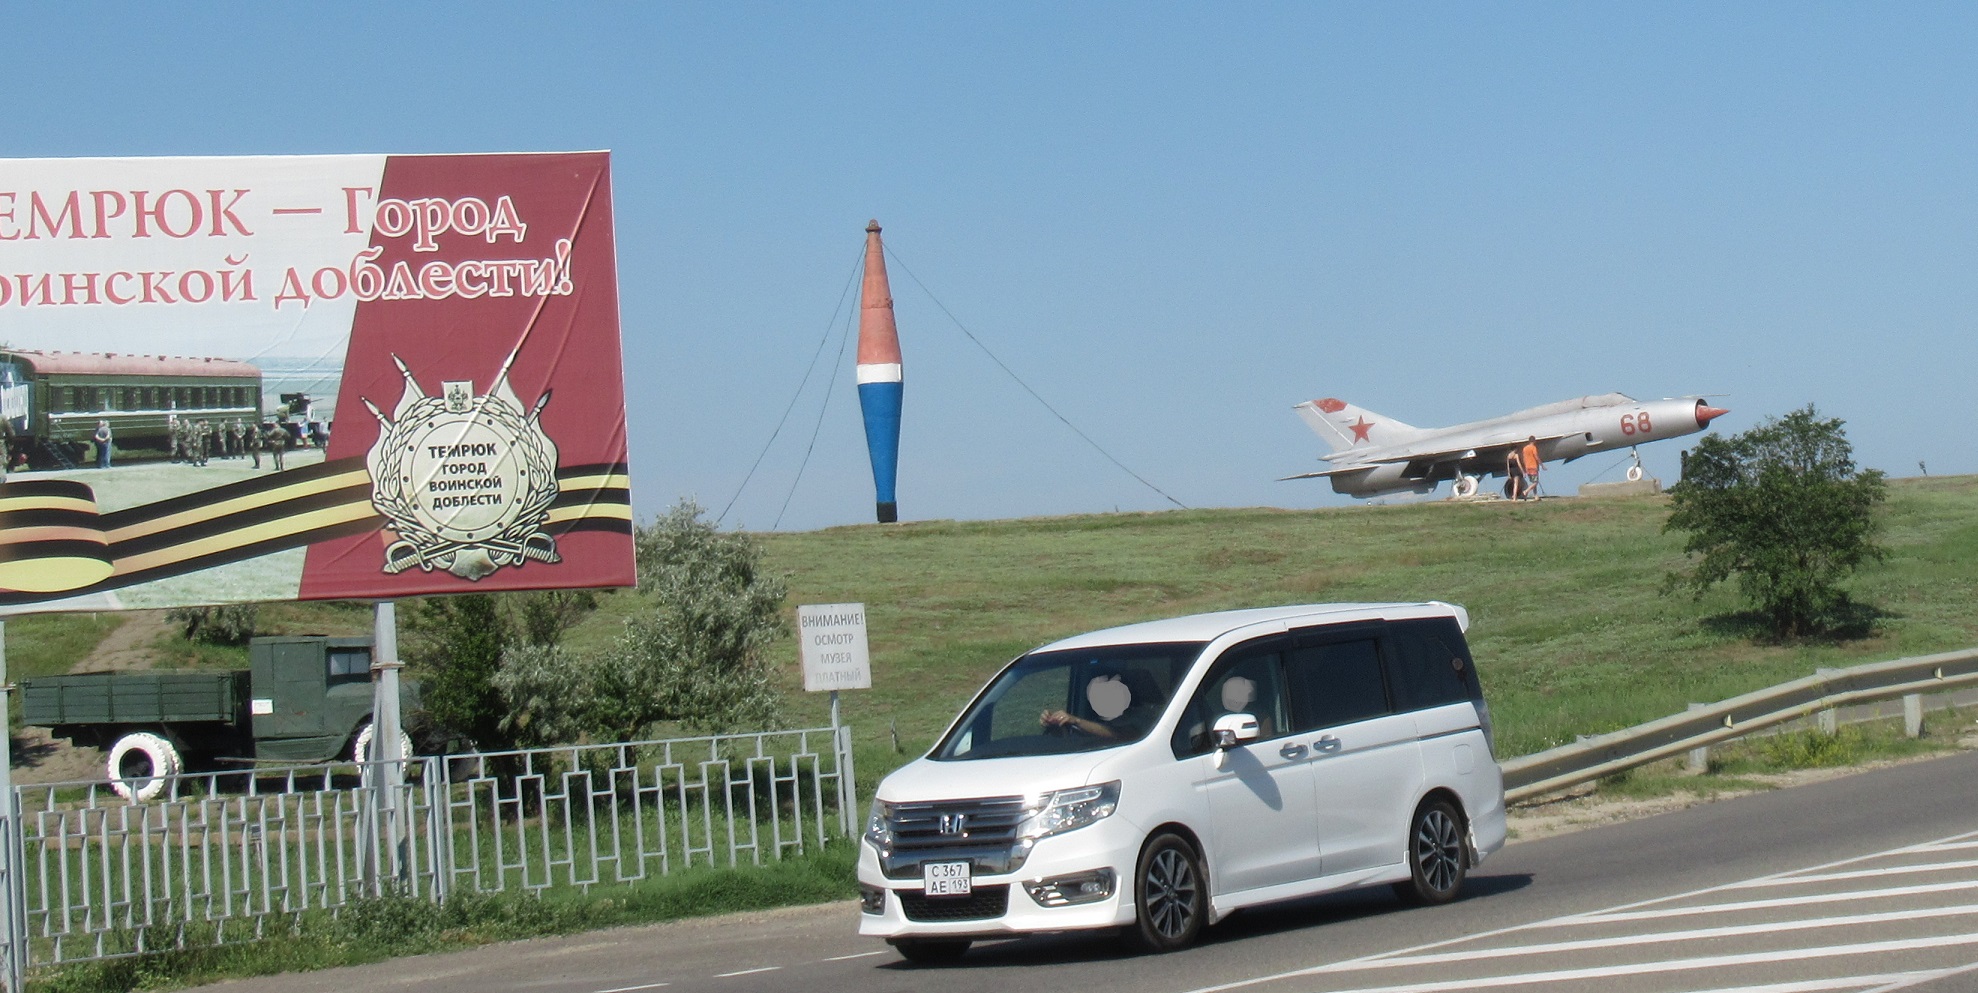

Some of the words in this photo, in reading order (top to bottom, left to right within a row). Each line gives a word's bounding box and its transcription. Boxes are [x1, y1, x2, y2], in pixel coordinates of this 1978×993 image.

[341, 187, 526, 252] Город
[274, 238, 574, 310] доблести!
[1620, 411, 1652, 436] 68
[428, 442, 498, 459] ТЕМРЮК
[442, 462, 487, 475] ГОРОД
[429, 475, 502, 492] ВОИНСКОЙ
[432, 493, 502, 510] ДОБЛЕСТИ
[801, 613, 864, 628] ВНИМАНИЕ!
[814, 633, 854, 646] ОСМОТР
[821, 652, 852, 664] МУЗЕЯ
[815, 667, 862, 684] ПЛАТНЫЙ
[943, 864, 963, 877] 367
[952, 878, 968, 889] 193
